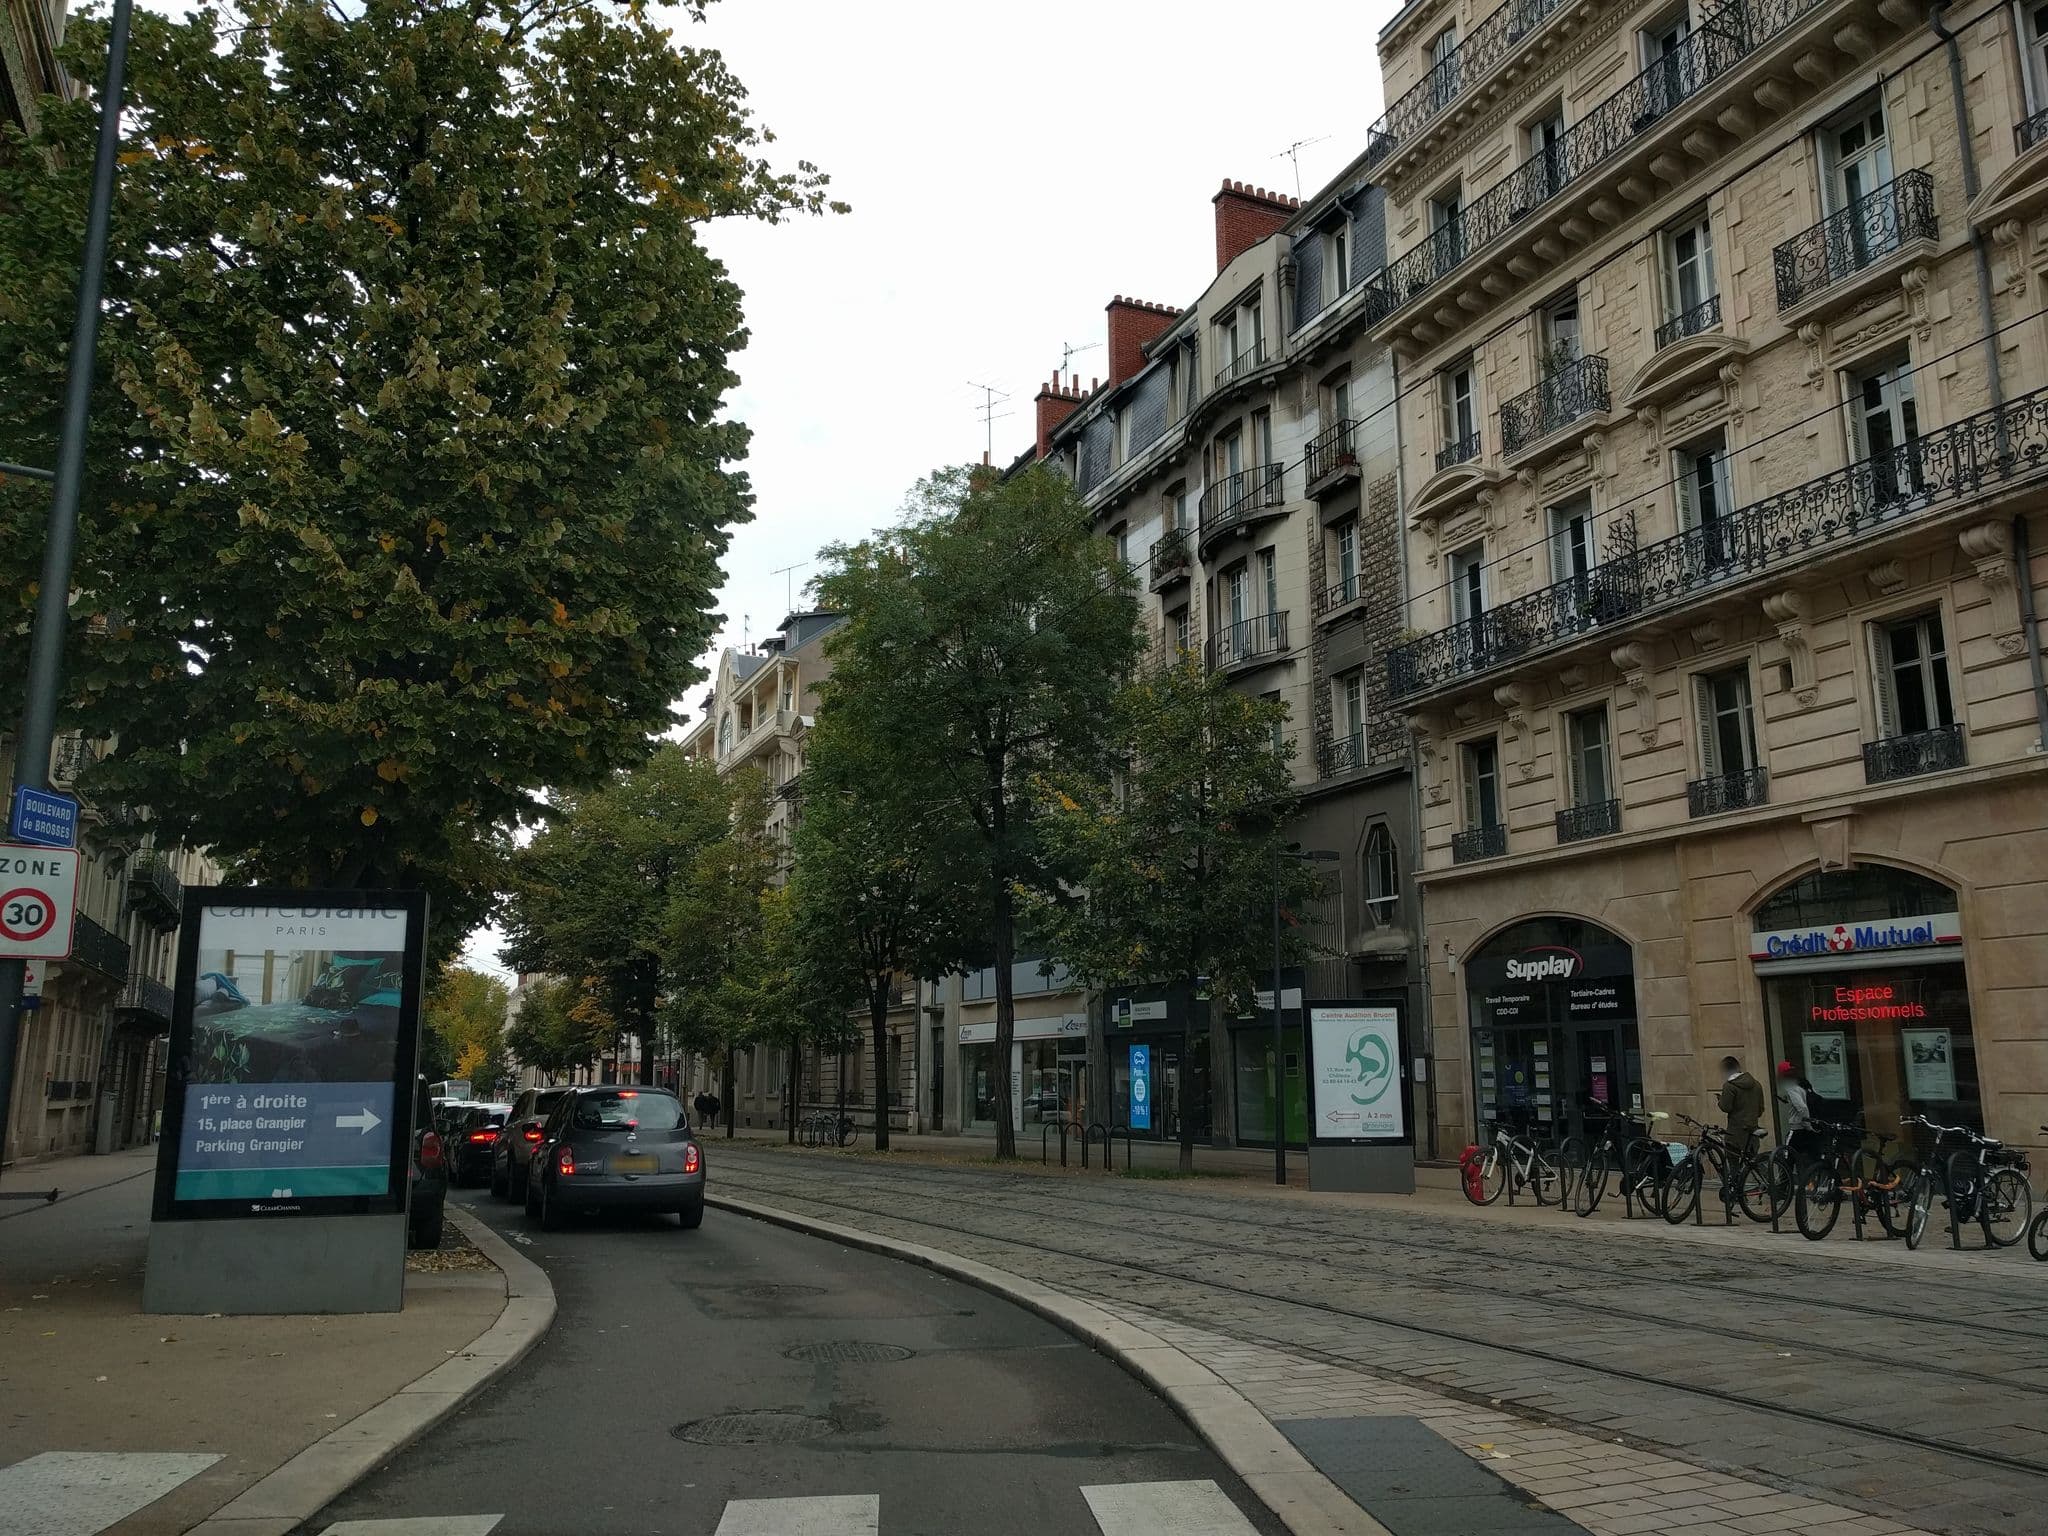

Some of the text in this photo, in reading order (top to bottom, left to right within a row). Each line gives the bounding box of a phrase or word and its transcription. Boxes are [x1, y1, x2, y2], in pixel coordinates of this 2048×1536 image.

[26, 799, 71, 821] BOULEVARD
[23, 817, 70, 839] de BROSSES
[0, 858, 61, 877] ZONE
[6, 902, 43, 926] 30
[276, 926, 326, 936] PARIS
[1767, 921, 1934, 957] Crédit Mutuel
[1506, 955, 1575, 981] Supplay
[1485, 994, 1530, 1004] Travail Temporaire
[1835, 985, 1893, 1004] Espace
[1570, 1002, 1590, 1011] Bureau
[1598, 1001, 1618, 1009] études
[1812, 1002, 1925, 1021] Professionnels
[201, 1094, 307, 1109] 1ère à droite
[198, 1117, 306, 1132] 15, place Grangier
[196, 1138, 304, 1153] Parking Grangier
